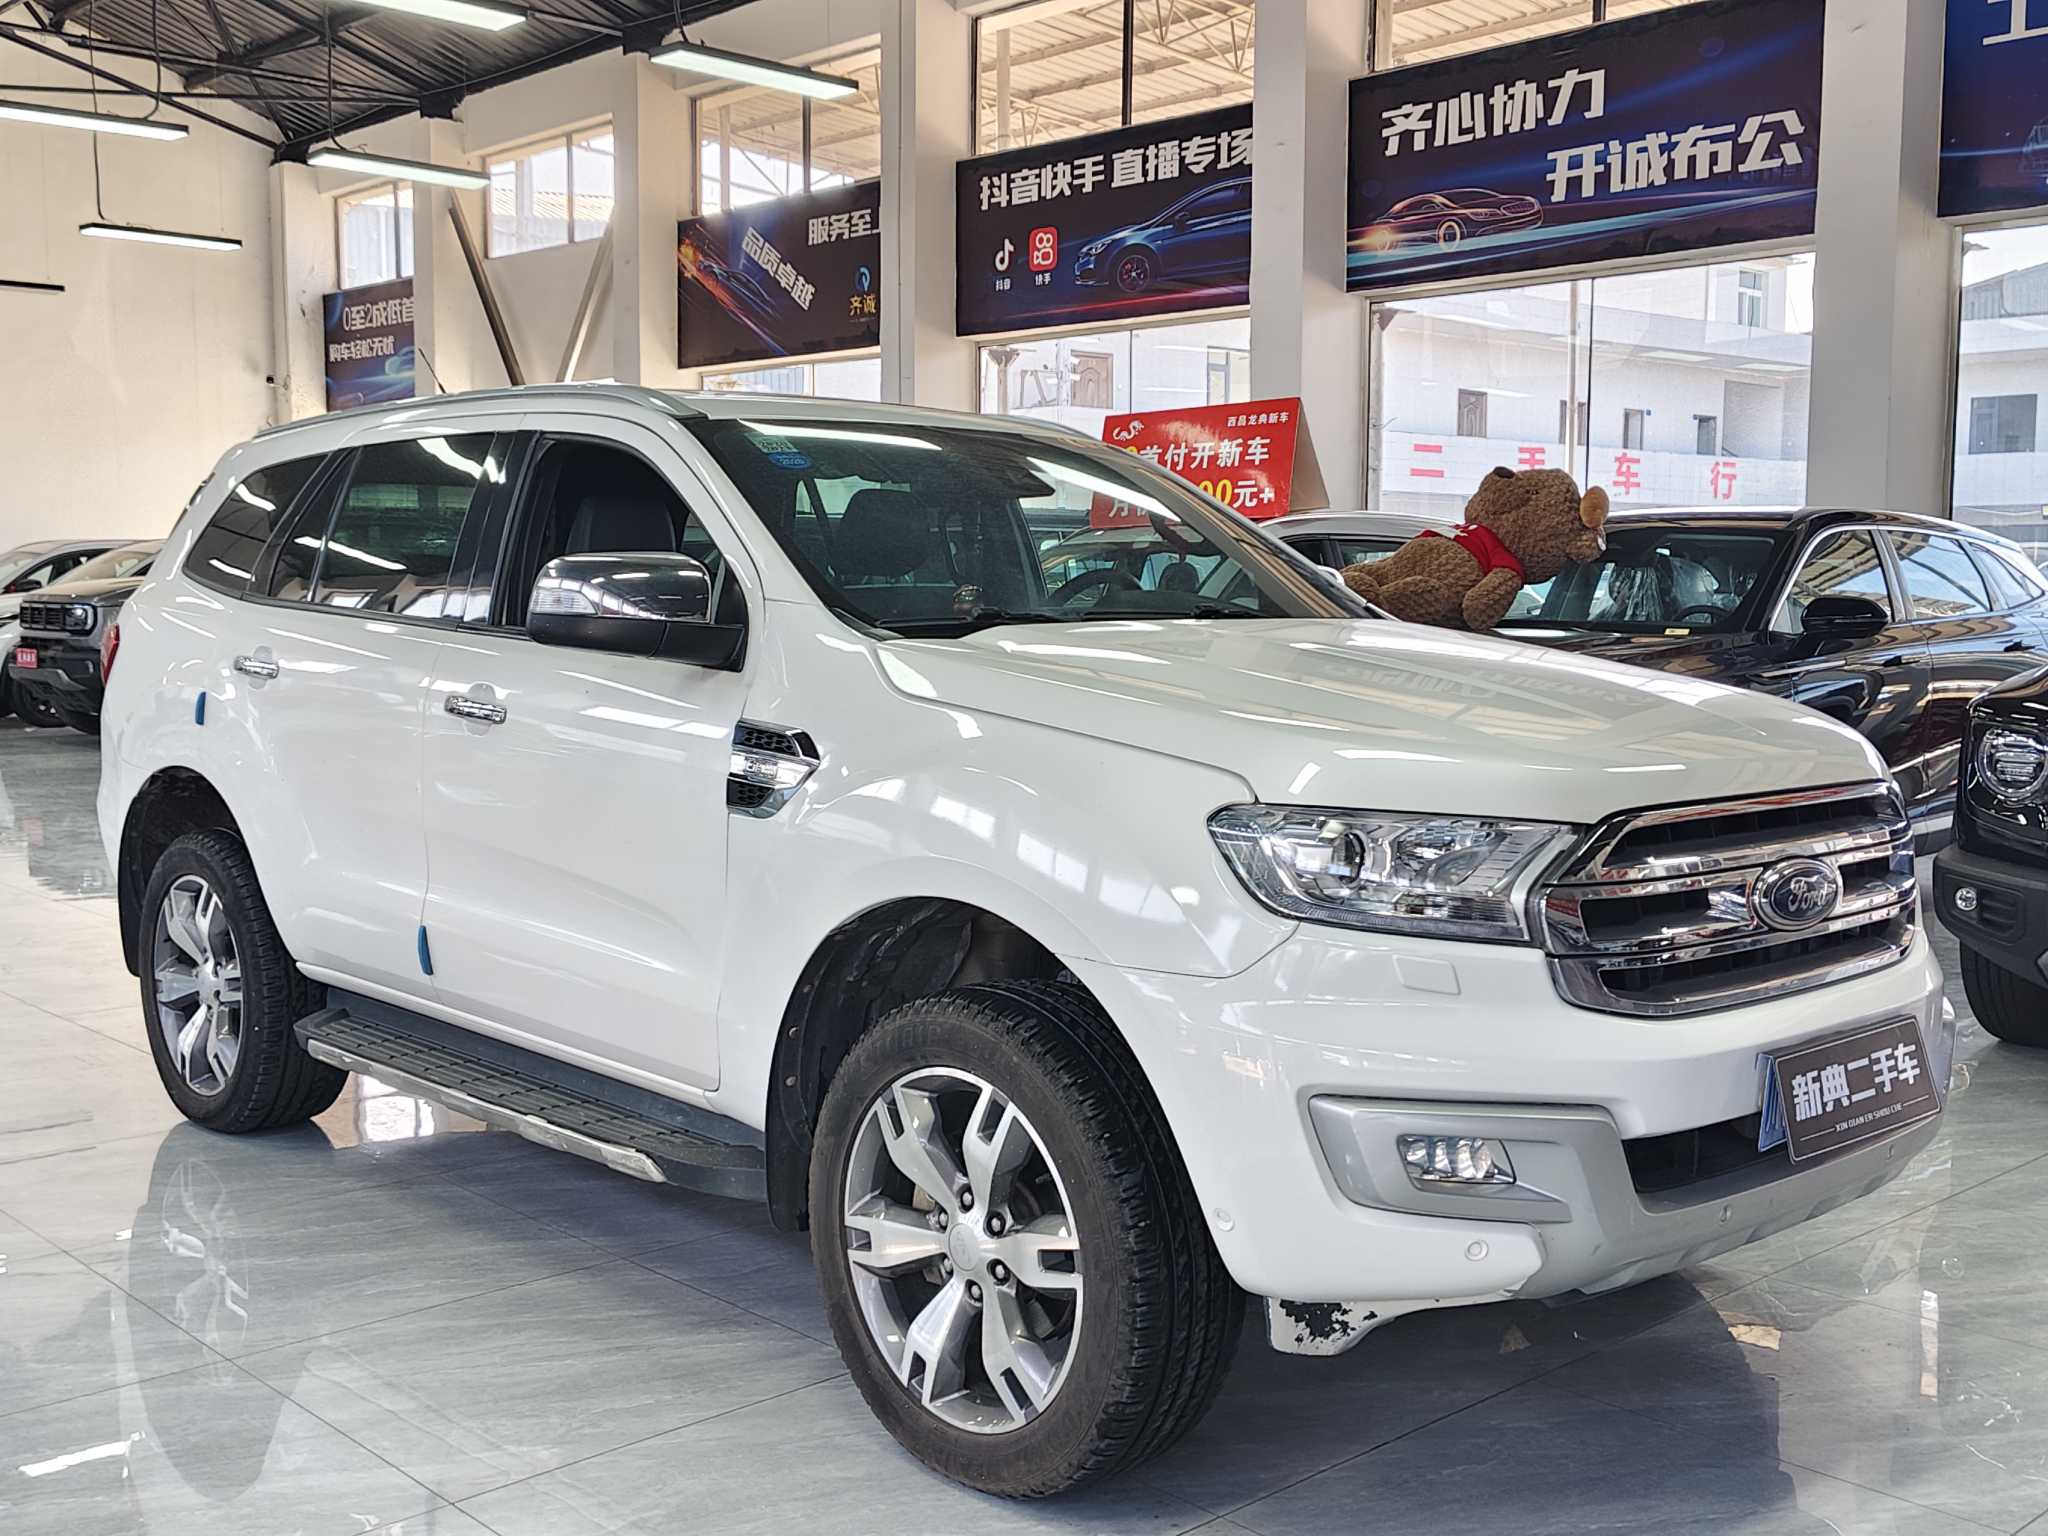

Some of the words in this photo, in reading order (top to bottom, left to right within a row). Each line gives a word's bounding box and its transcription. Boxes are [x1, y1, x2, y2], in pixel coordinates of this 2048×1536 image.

[1381, 67, 1606, 156] 齐心协力
[979, 155, 1105, 210] 抖音快手
[1111, 127, 1254, 189] 直播专场
[1545, 110, 1806, 203] 开诚布公
[741, 227, 816, 311] 品质卓越
[1035, 272, 1052, 286] 快手
[849, 293, 877, 317] 齐诚
[329, 336, 395, 362] 购车轻松无忧
[1788, 873, 1830, 912] Ford
[1791, 1043, 1921, 1122] 新典二手车
[1835, 1120, 1848, 1132] XIN
[1864, 1112, 1874, 1123] ER
[1890, 1102, 1902, 1113] CHE
